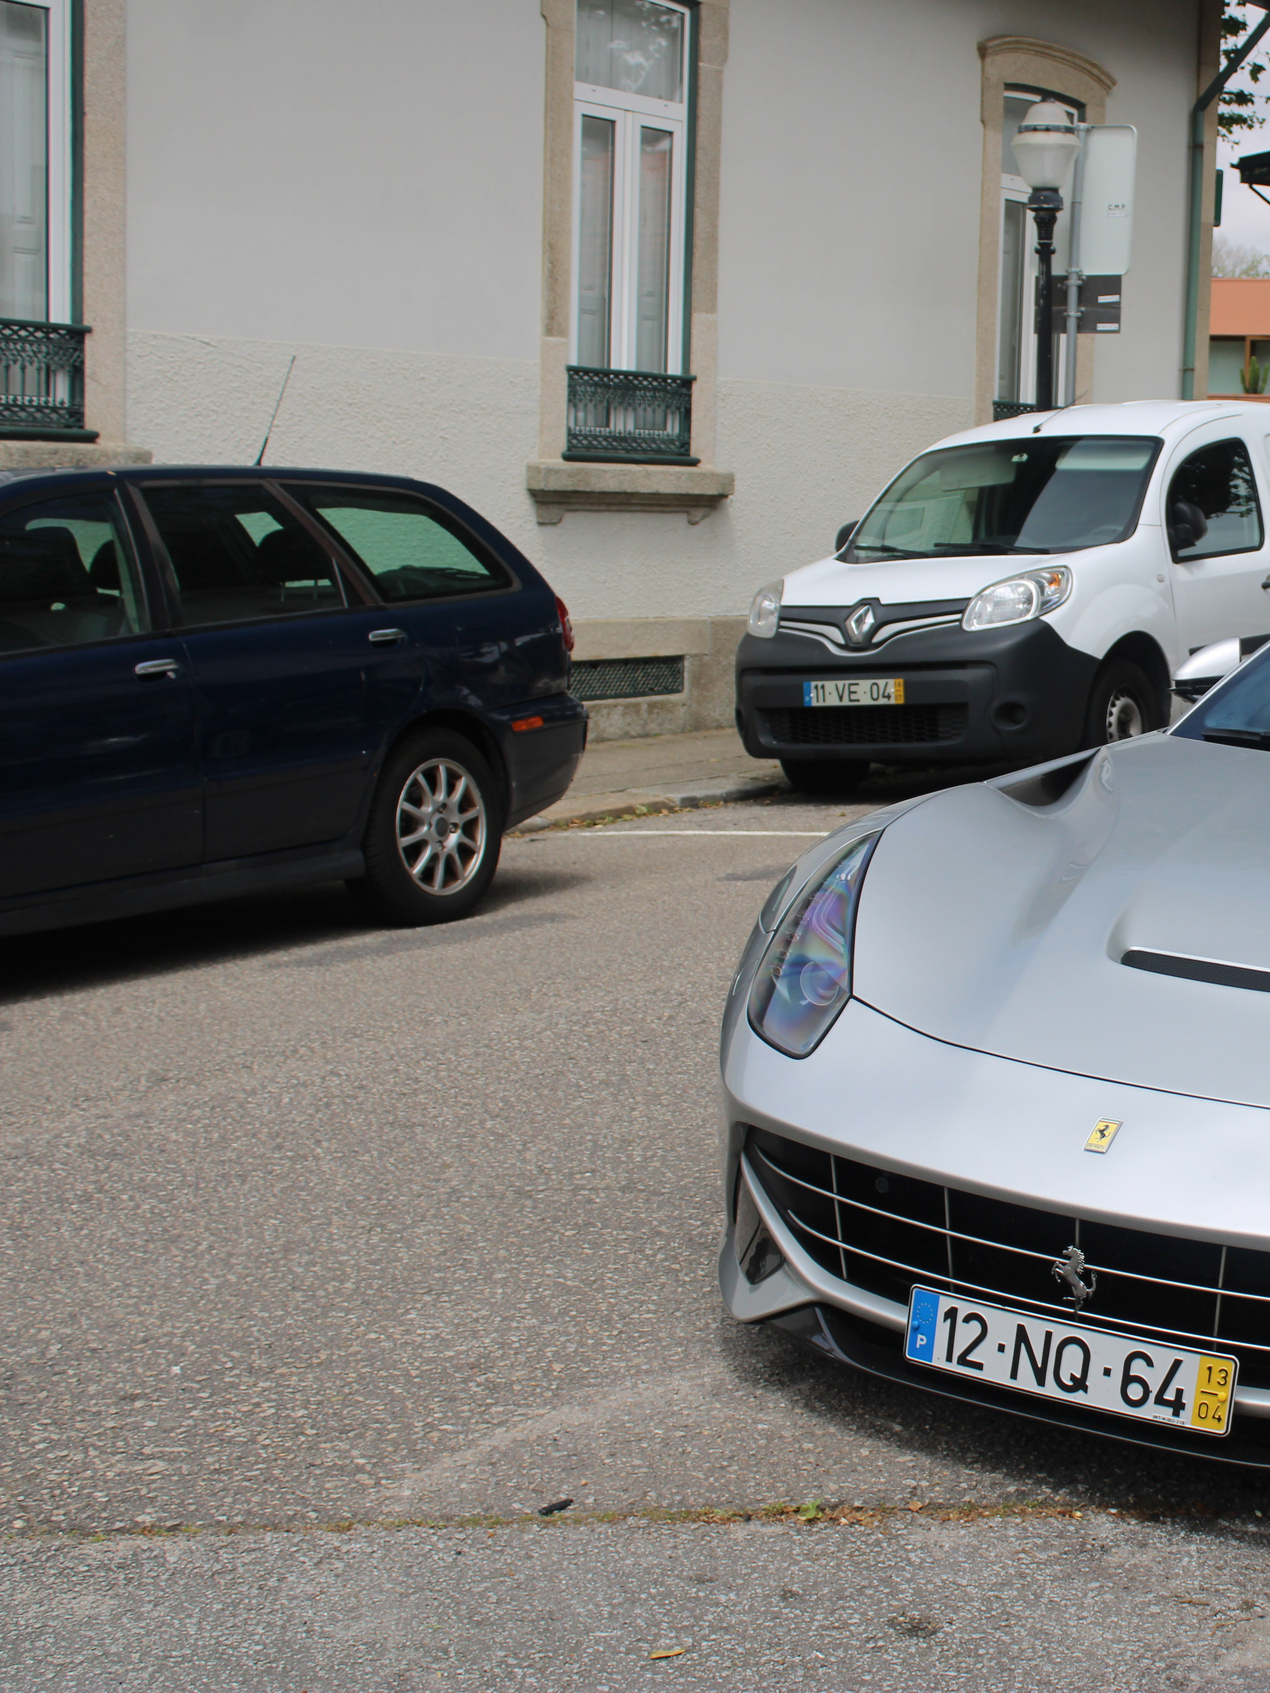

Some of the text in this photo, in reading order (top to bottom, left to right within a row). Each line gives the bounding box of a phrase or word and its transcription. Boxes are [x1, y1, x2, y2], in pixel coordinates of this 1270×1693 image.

[916, 1333, 928, 1349] P
[1205, 1365, 1229, 1387] 13
[1197, 1401, 1223, 1424] 04
